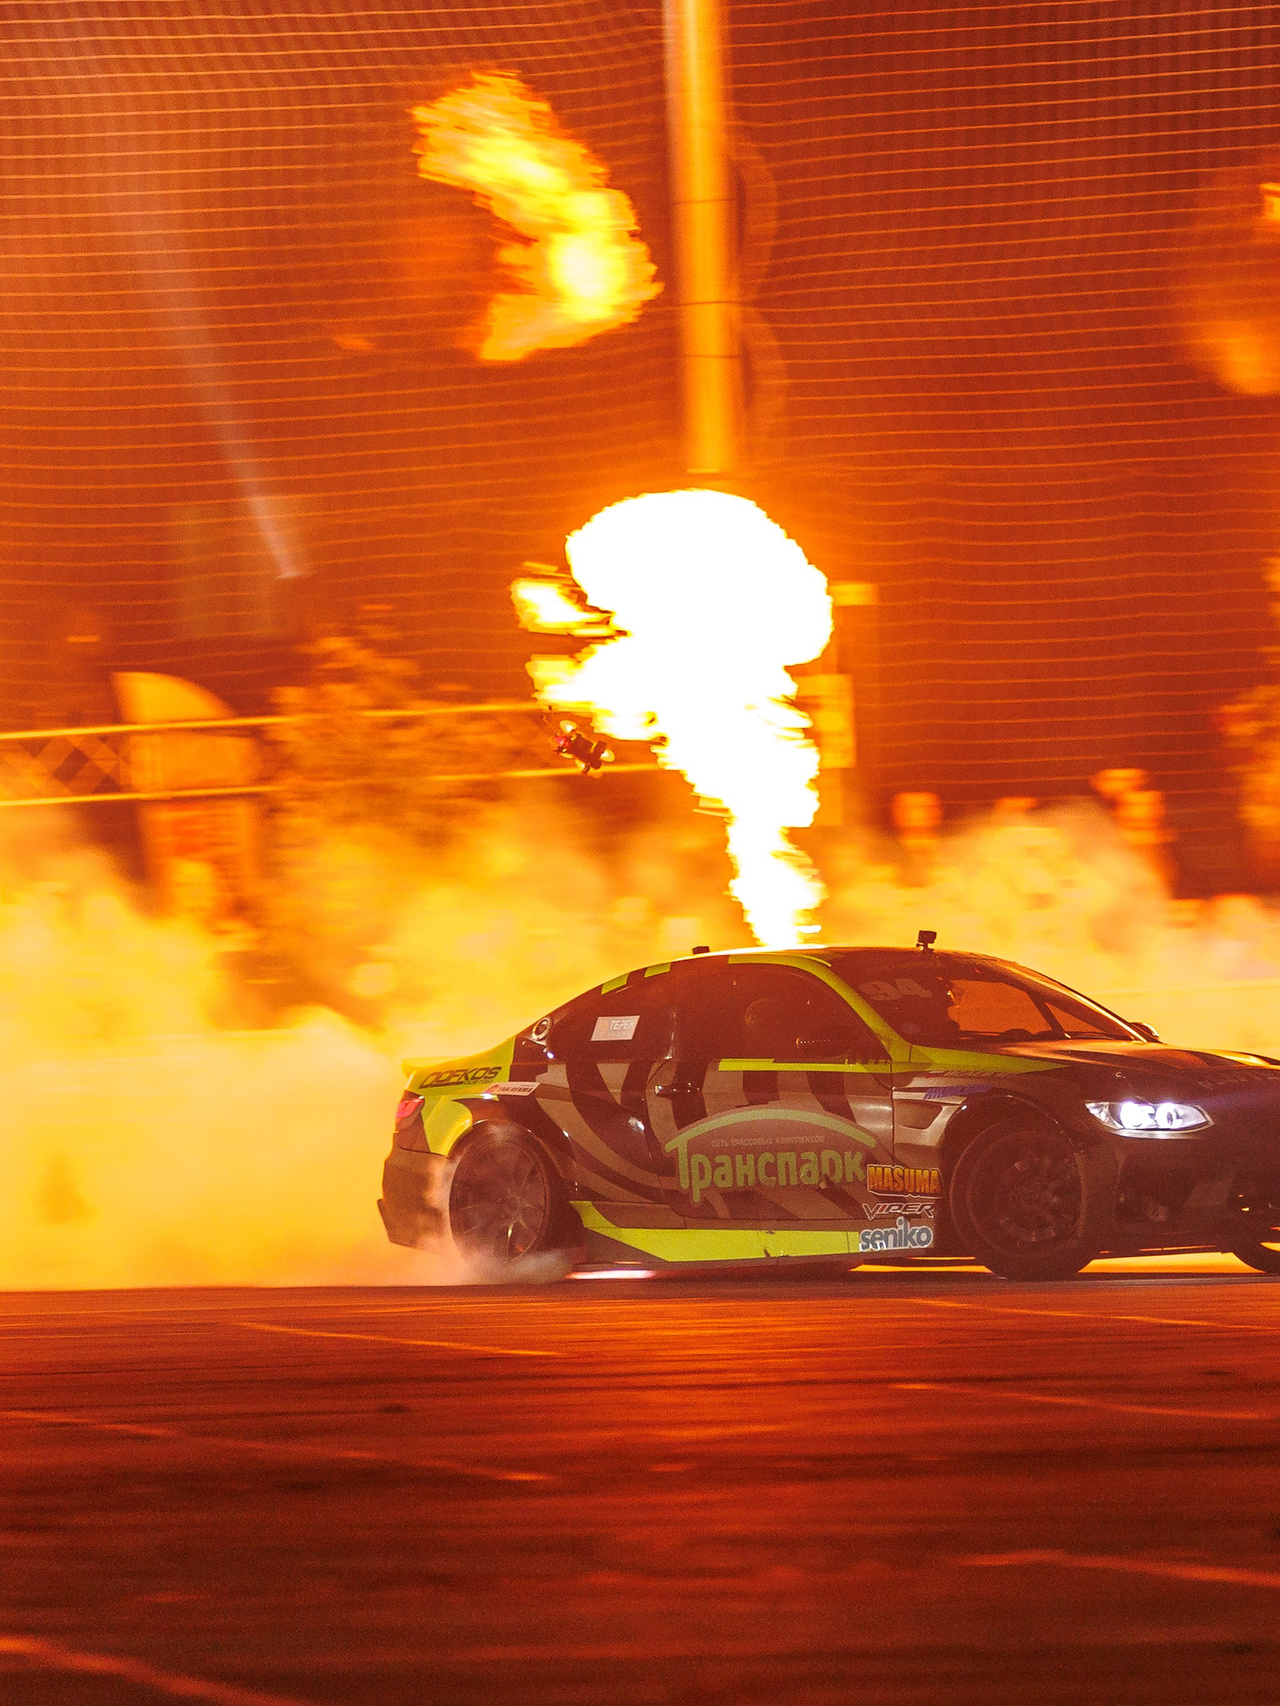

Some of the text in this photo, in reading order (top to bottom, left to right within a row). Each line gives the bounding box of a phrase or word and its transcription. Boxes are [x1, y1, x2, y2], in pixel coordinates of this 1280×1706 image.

[666, 1118, 872, 1203] Транспарк
[867, 1165, 942, 1196] MASUMA
[862, 1203, 935, 1221] VIPER
[860, 1216, 934, 1252] seniko
